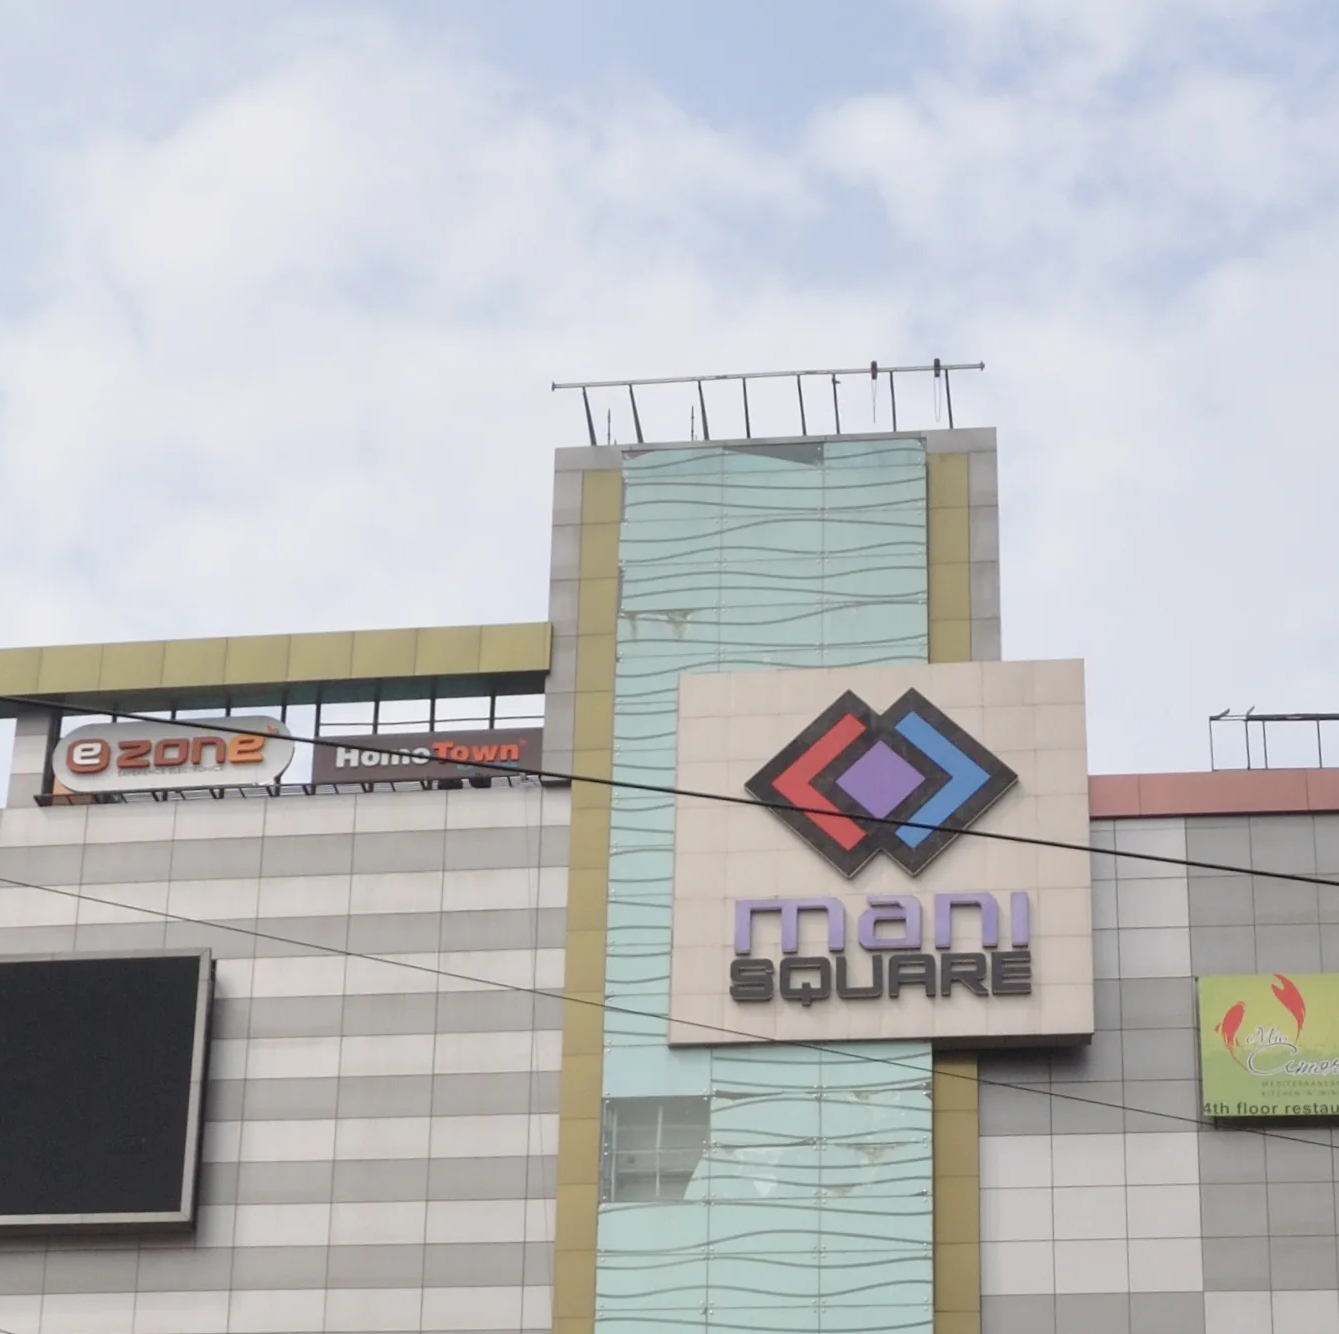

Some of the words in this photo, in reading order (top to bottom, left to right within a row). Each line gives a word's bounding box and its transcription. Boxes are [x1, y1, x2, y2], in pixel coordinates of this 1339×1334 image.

[730, 951, 1032, 1006] SQUARE
[1203, 1102, 1230, 1115] 4th
[1237, 1102, 1278, 1115] floor
